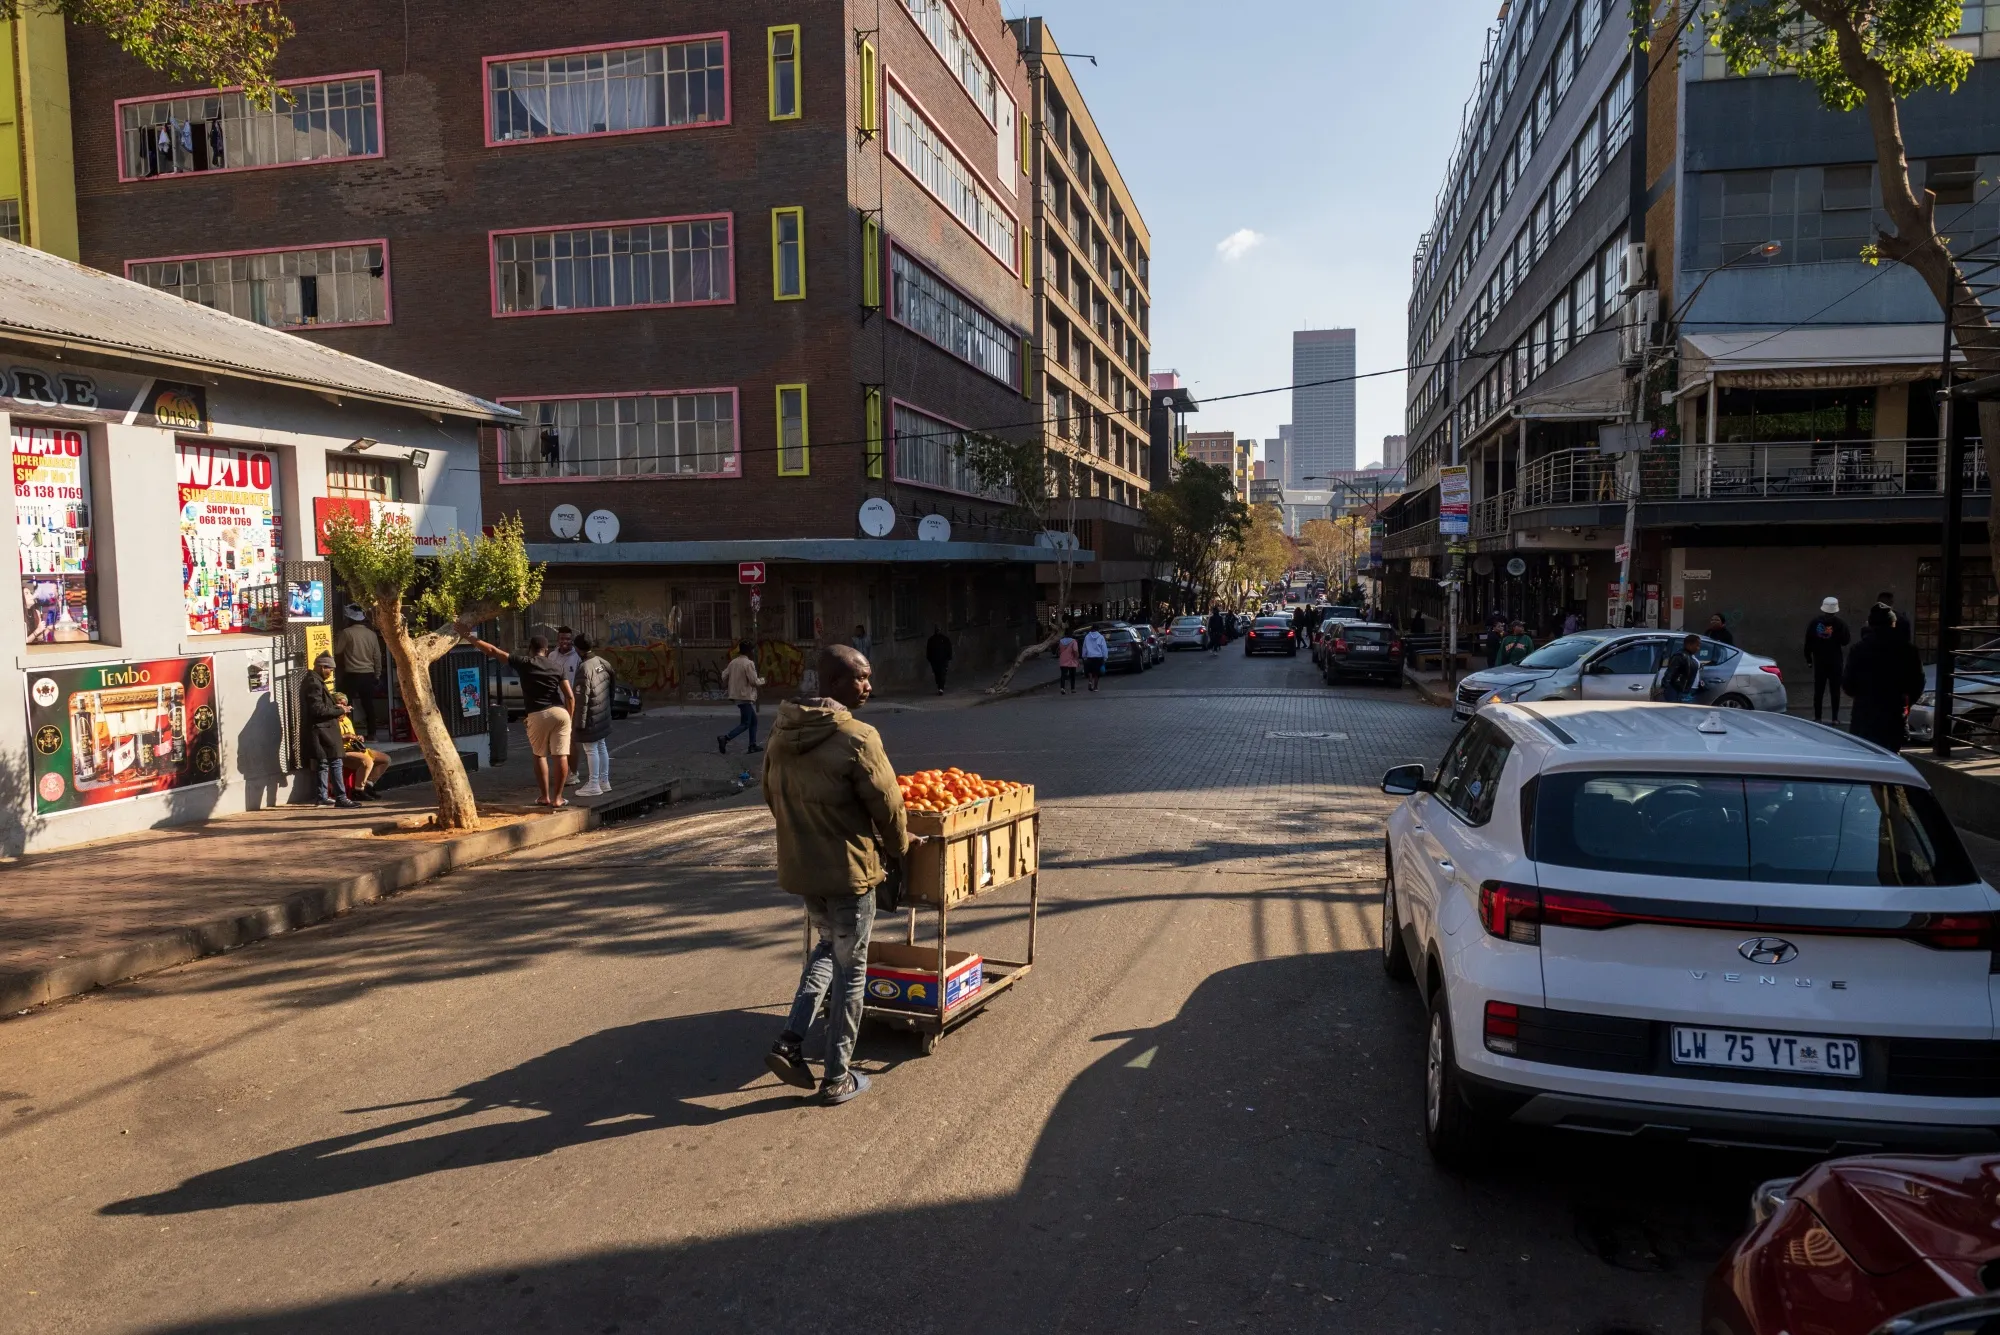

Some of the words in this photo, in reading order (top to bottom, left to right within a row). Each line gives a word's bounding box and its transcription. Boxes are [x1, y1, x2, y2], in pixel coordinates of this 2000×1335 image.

[13, 454, 77, 469] UPERMARKET
[175, 444, 272, 490] WAJO
[16, 467, 48, 482] SHOP
[34, 485, 55, 498] 138
[57, 486, 83, 500] 1769
[182, 487, 269, 506] SUPERMARKET
[206, 505, 228, 514] SHOP
[200, 516, 216, 525] 068
[218, 516, 232, 526] 138
[233, 517, 252, 526] 1769
[1688, 969, 1847, 990] VENUE
[1677, 1030, 1706, 1060] LW
[1724, 1033, 1754, 1063] 75
[1768, 1037, 1797, 1066] YT
[1826, 1042, 1856, 1070] GP
